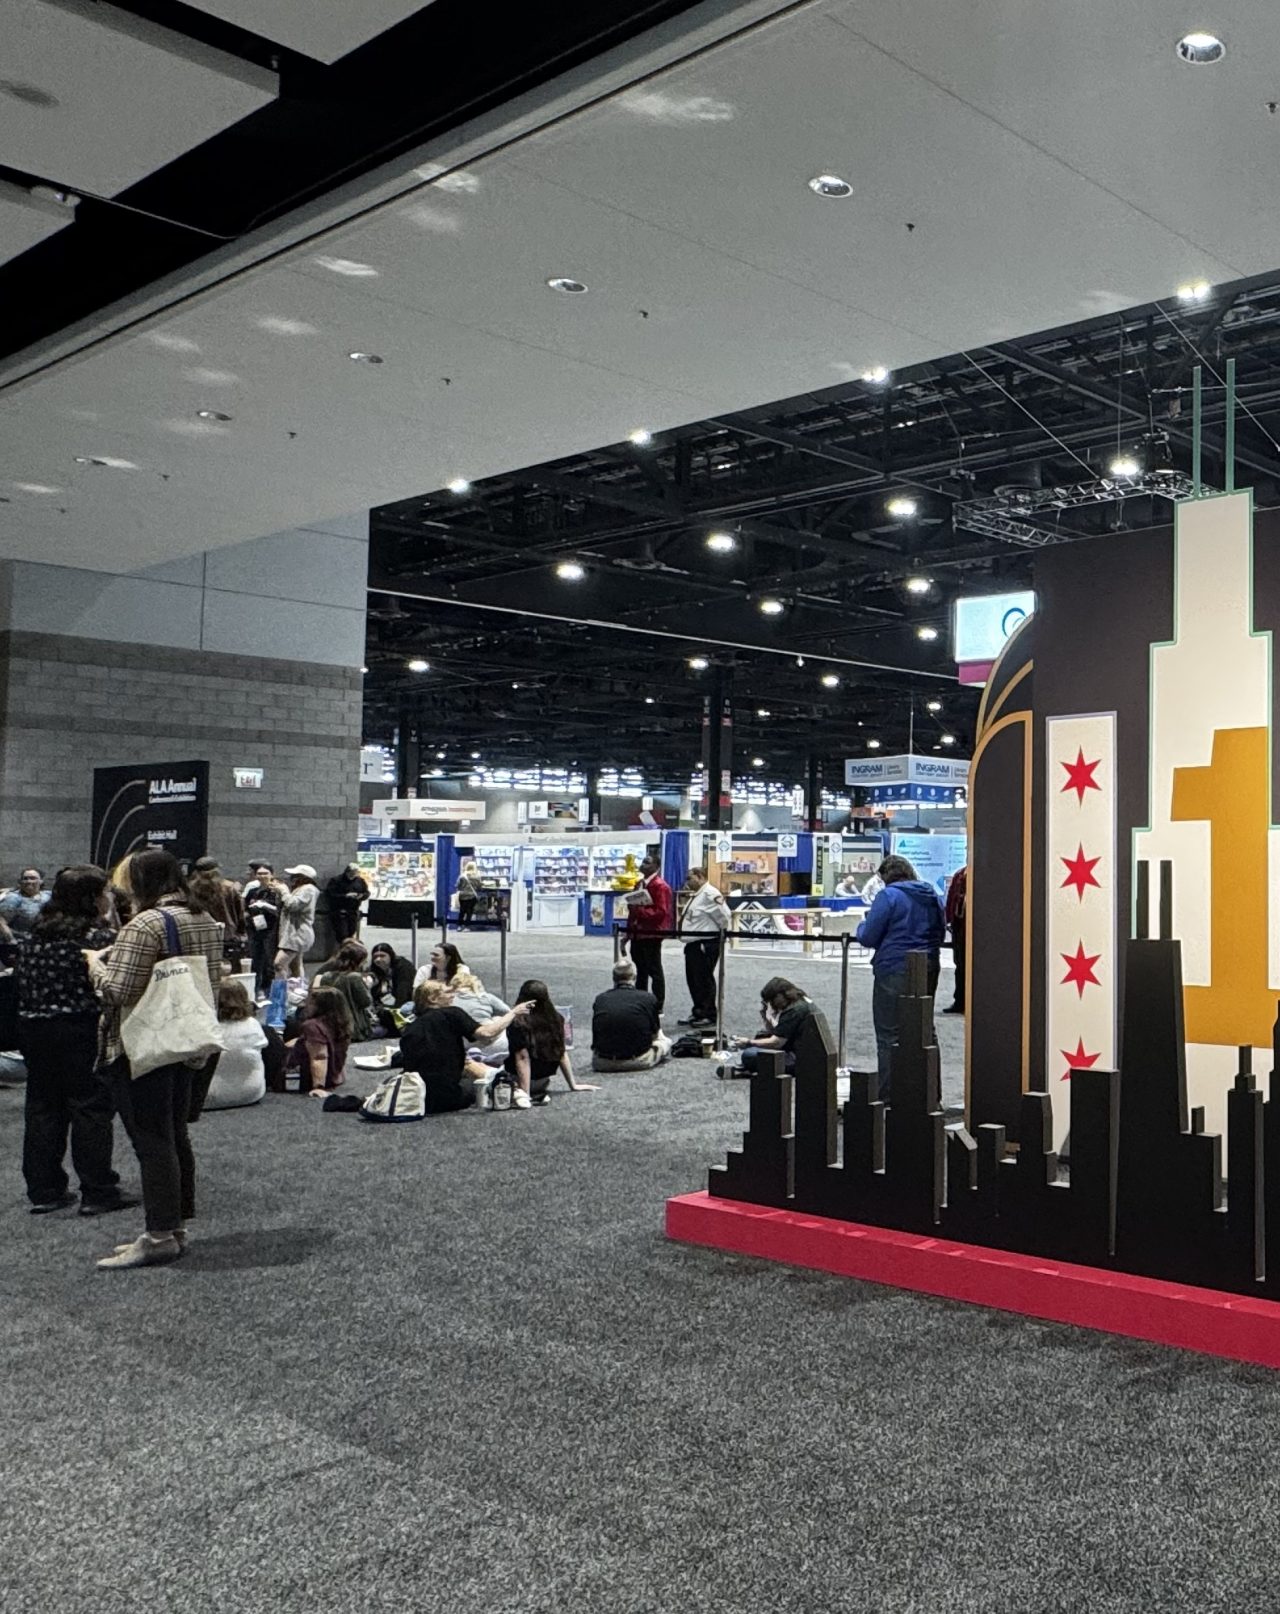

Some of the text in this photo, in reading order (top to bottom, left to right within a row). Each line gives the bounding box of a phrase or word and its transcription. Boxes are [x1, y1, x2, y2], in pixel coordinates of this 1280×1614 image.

[851, 764, 883, 774] INGRAM
[915, 762, 950, 774] INGRAM
[149, 777, 197, 795] ALA Annual
